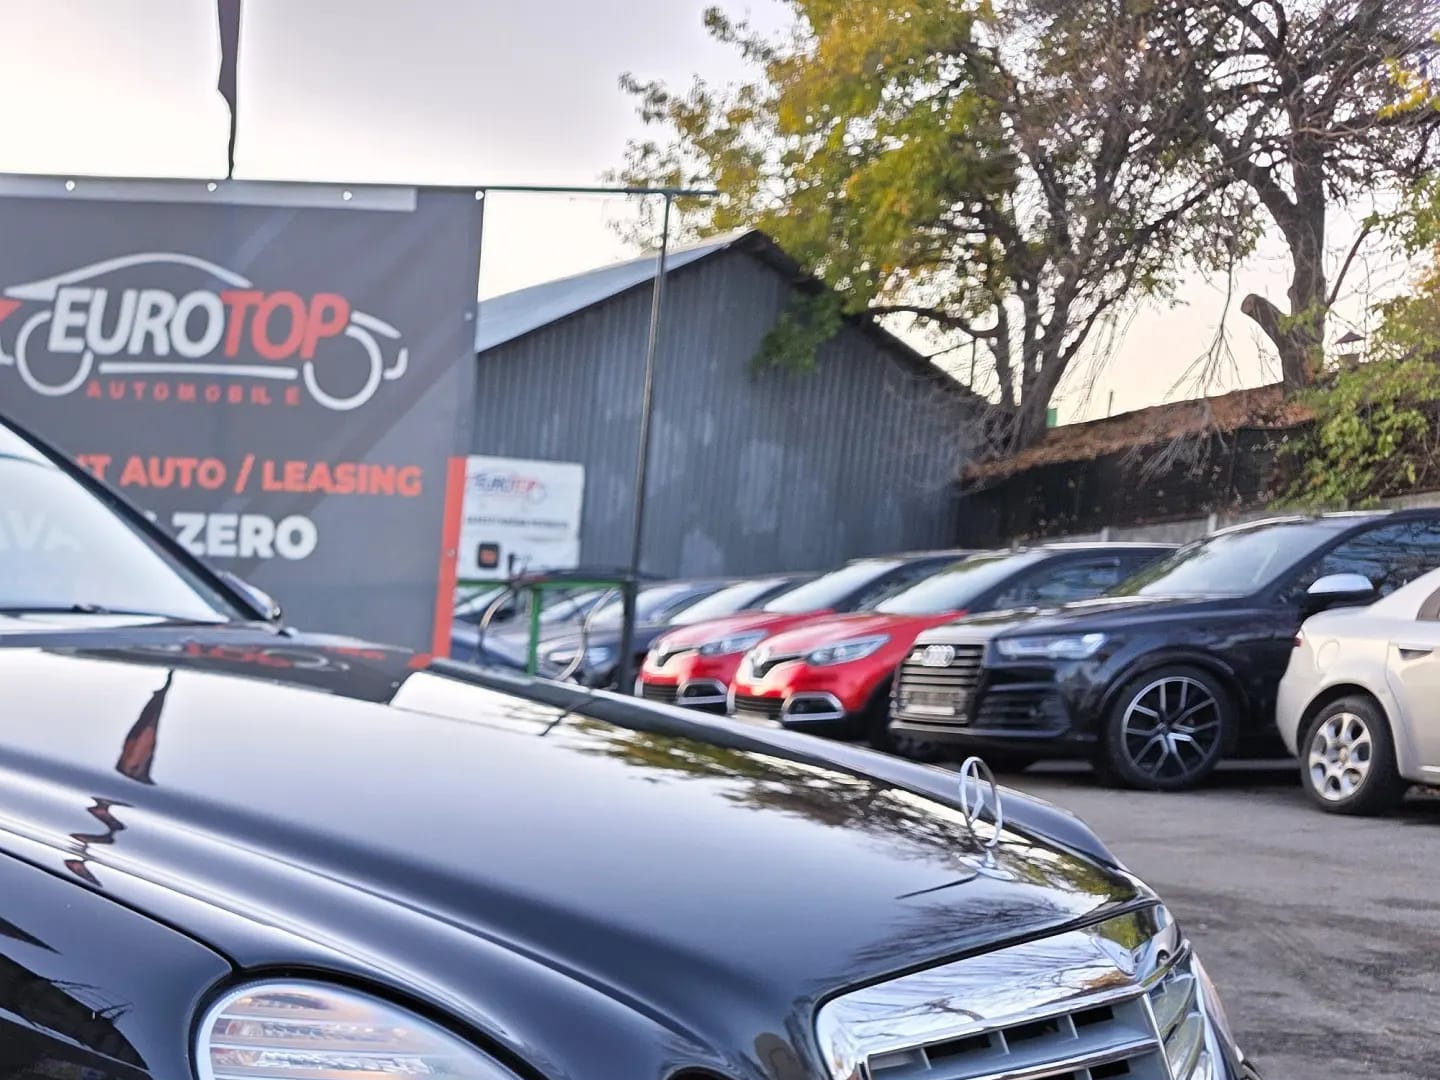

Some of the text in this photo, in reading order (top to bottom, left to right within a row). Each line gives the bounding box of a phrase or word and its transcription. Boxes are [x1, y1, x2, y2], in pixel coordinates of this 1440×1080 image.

[47, 286, 351, 360] EUROTOP
[86, 379, 302, 406] AUTOMOBILE
[119, 454, 227, 491] AUTO
[261, 459, 424, 497] LEASING
[172, 511, 318, 561] ZERO
